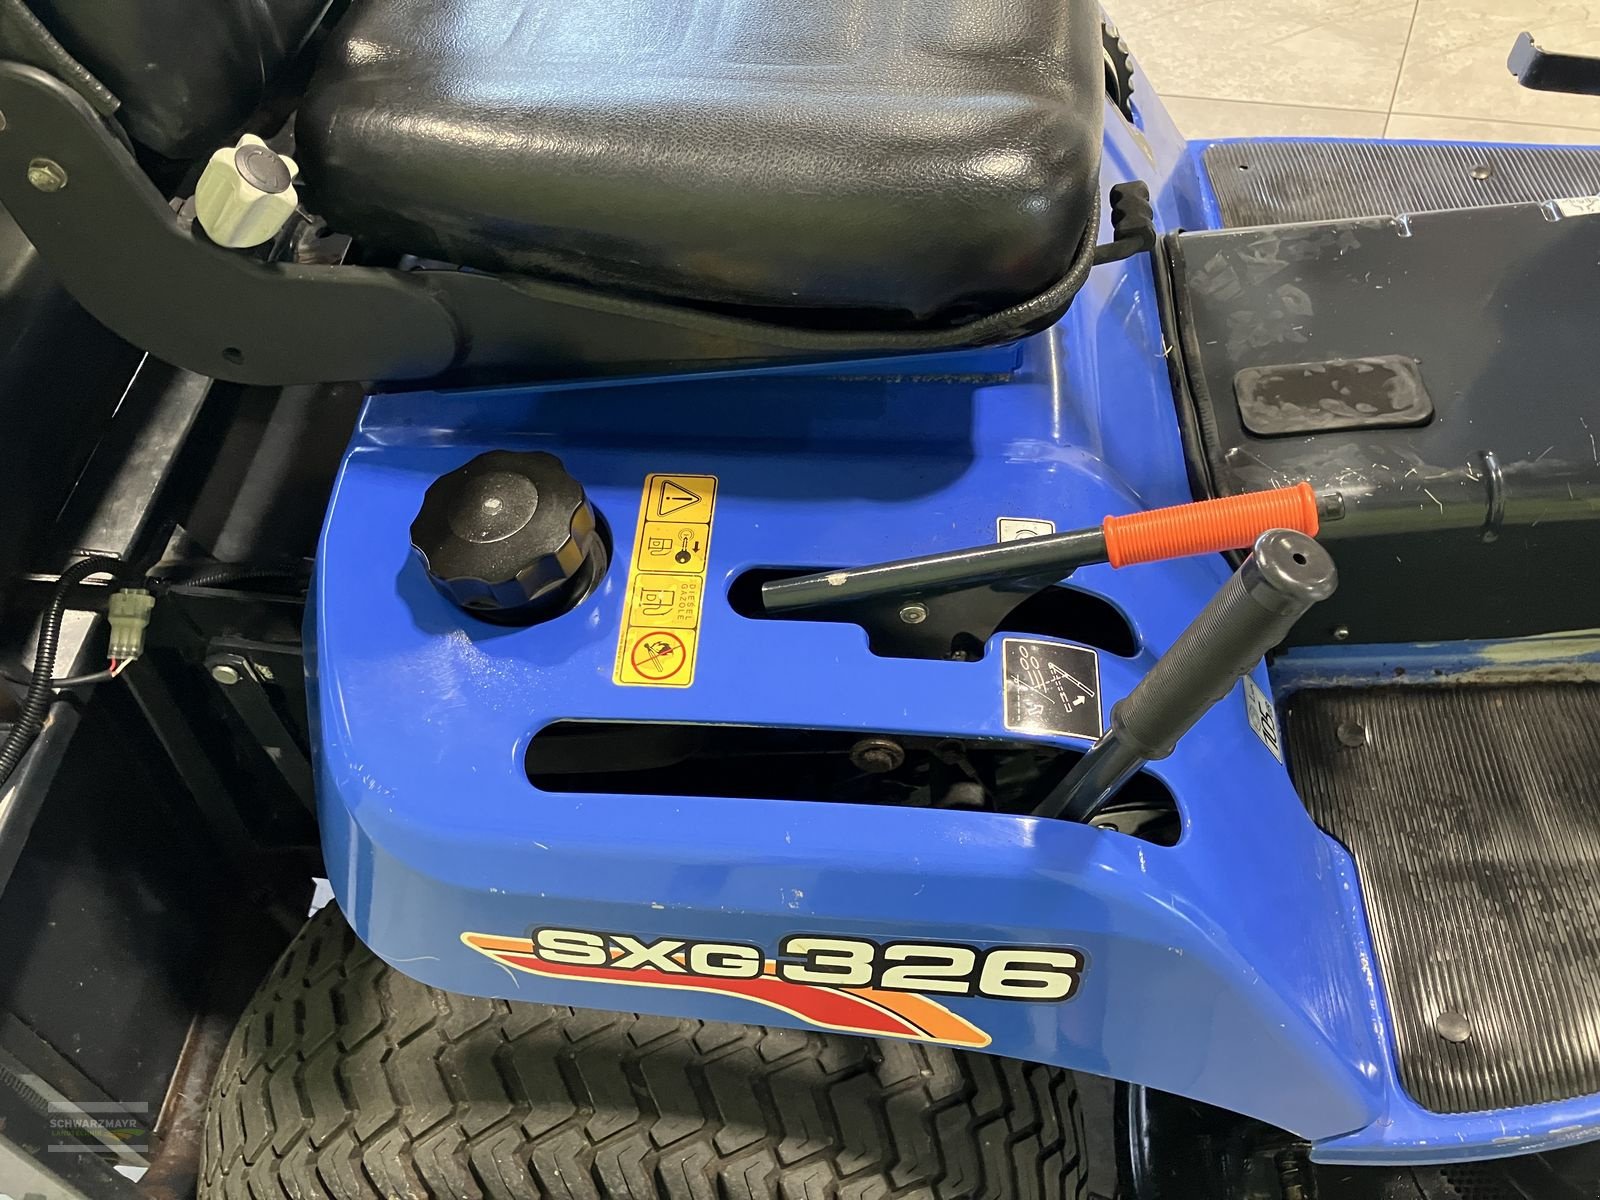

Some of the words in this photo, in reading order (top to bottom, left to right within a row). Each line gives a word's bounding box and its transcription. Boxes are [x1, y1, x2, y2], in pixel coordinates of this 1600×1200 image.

[677, 584, 688, 620] GAZOLE
[685, 584, 696, 620] DIESEL
[535, 928, 762, 978] SXG
[782, 937, 1078, 999] 326
